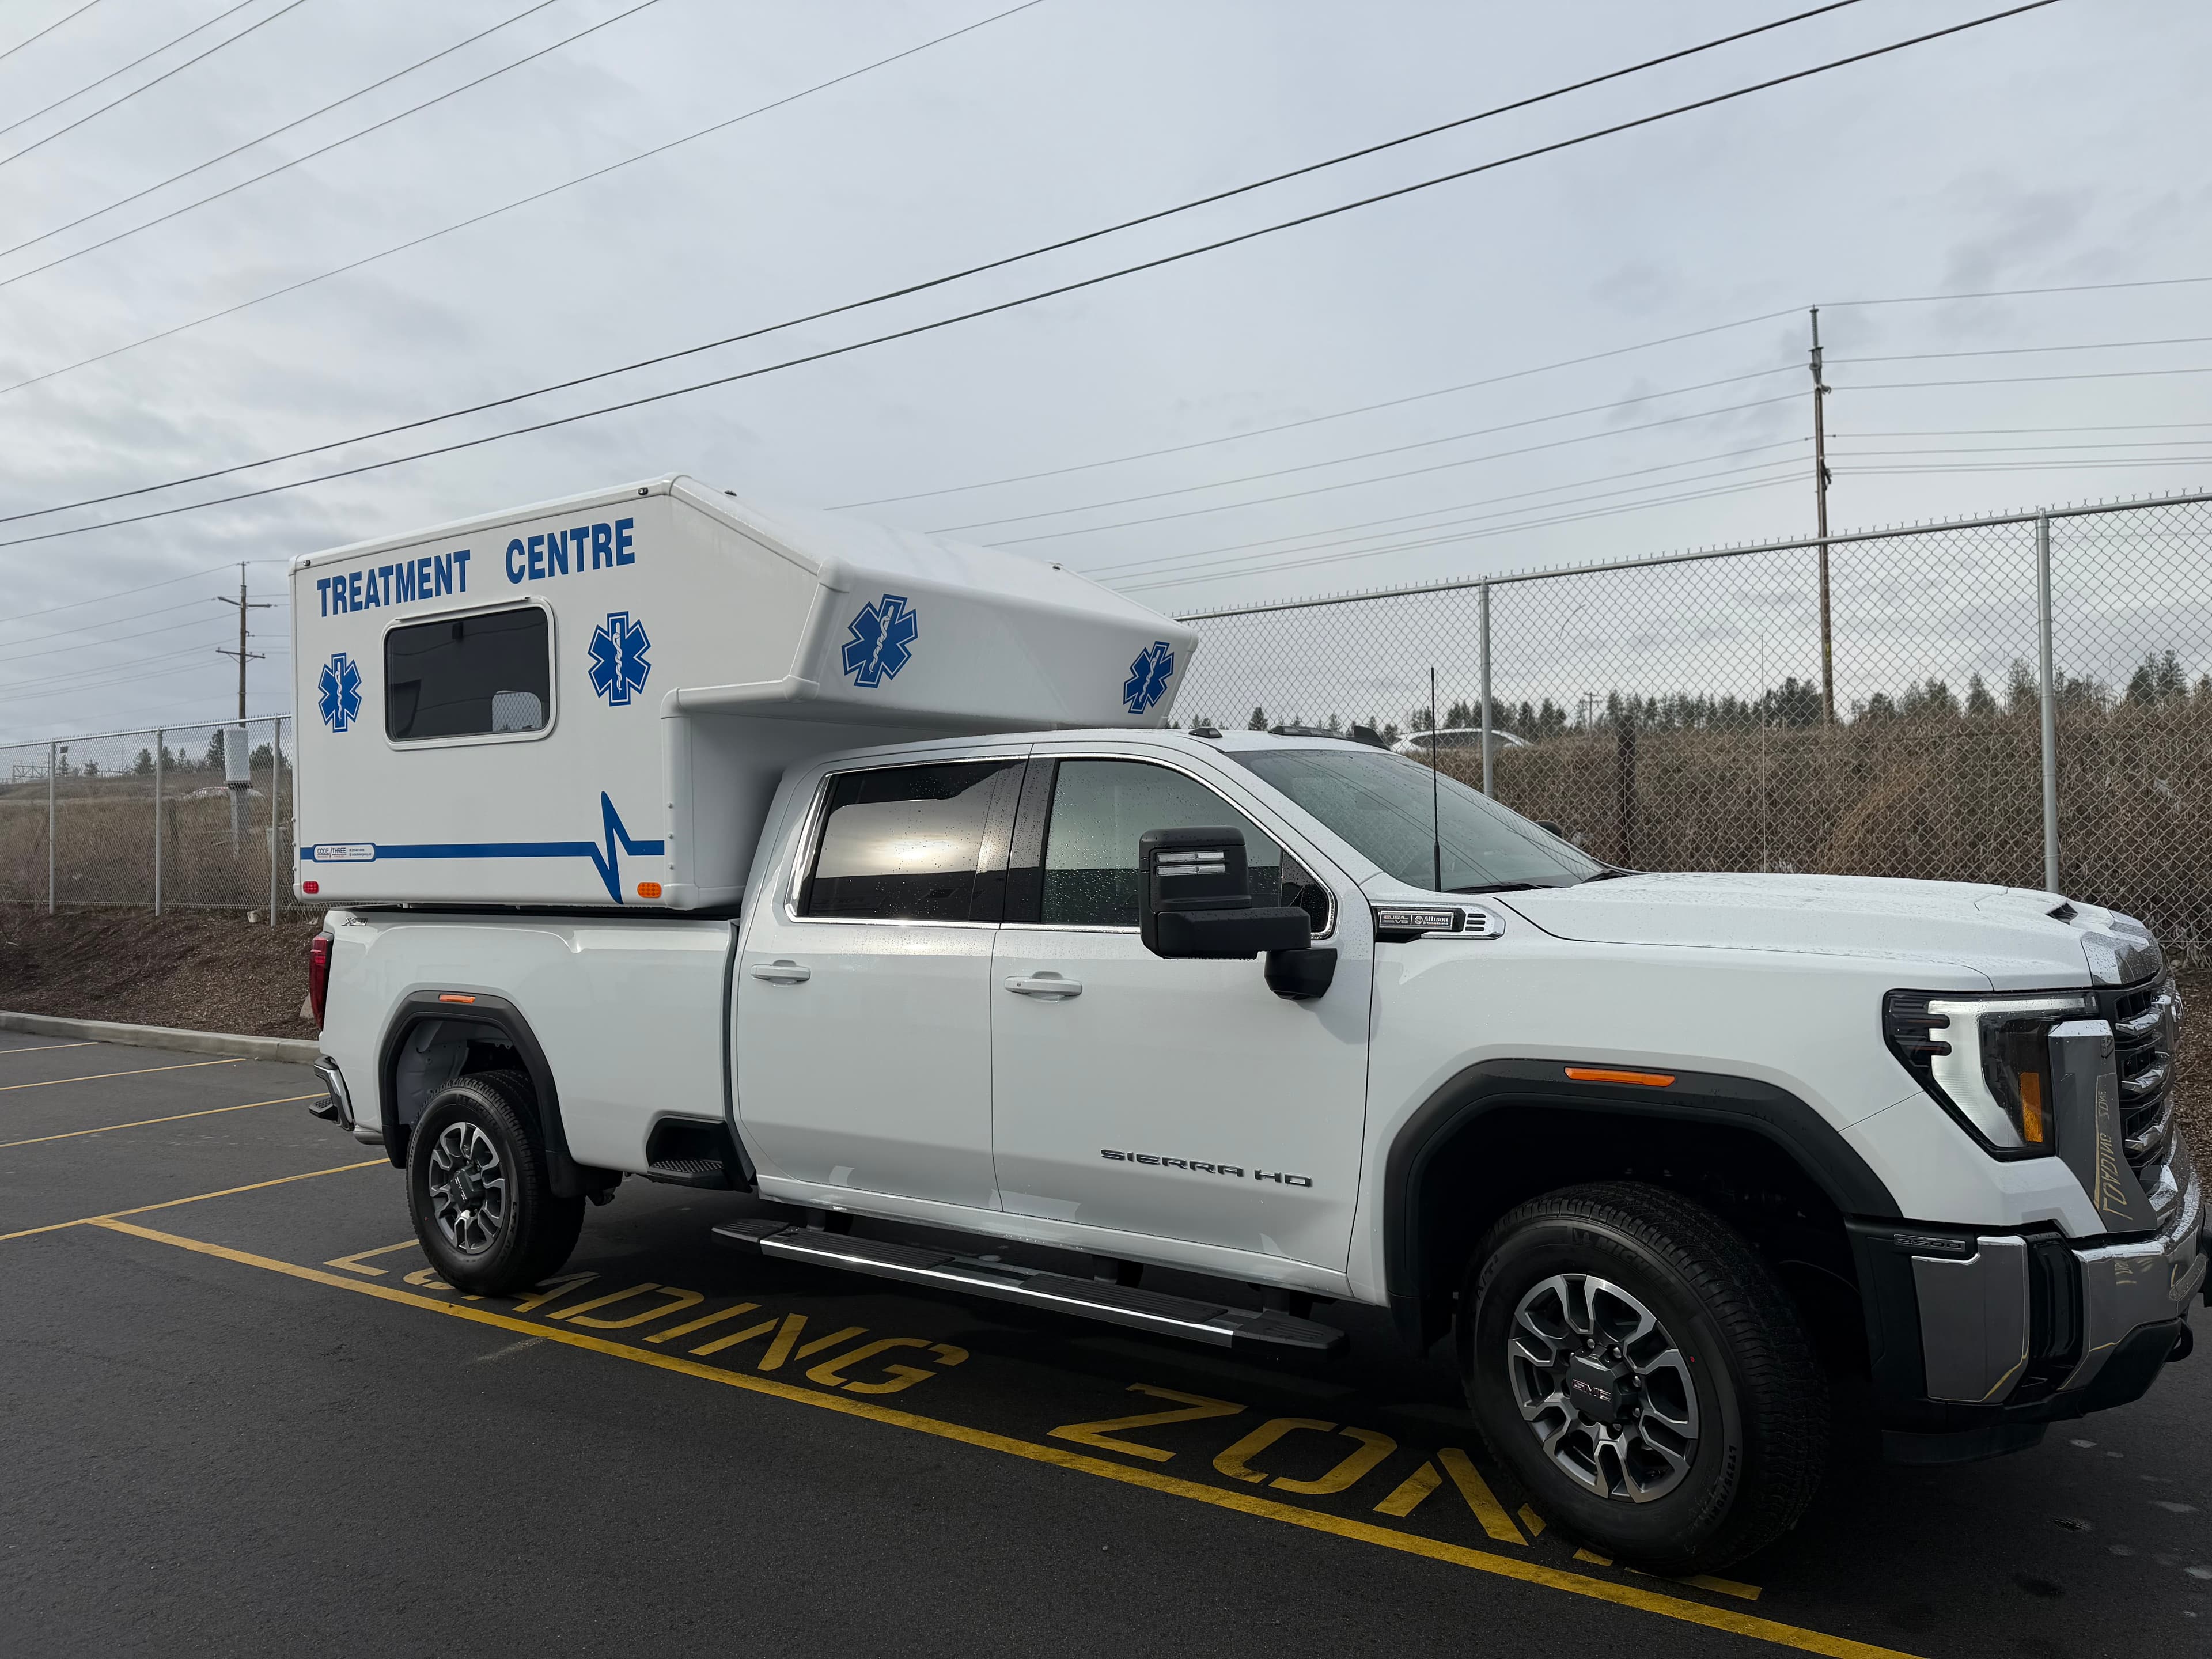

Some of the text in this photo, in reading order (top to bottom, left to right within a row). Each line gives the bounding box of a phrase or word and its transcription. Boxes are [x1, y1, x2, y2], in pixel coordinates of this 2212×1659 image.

[316, 517, 635, 617] TREATMENT CENTRE
[1101, 1148, 1313, 1188] SIERRA HD
[1572, 1378, 1613, 1402] GMC
